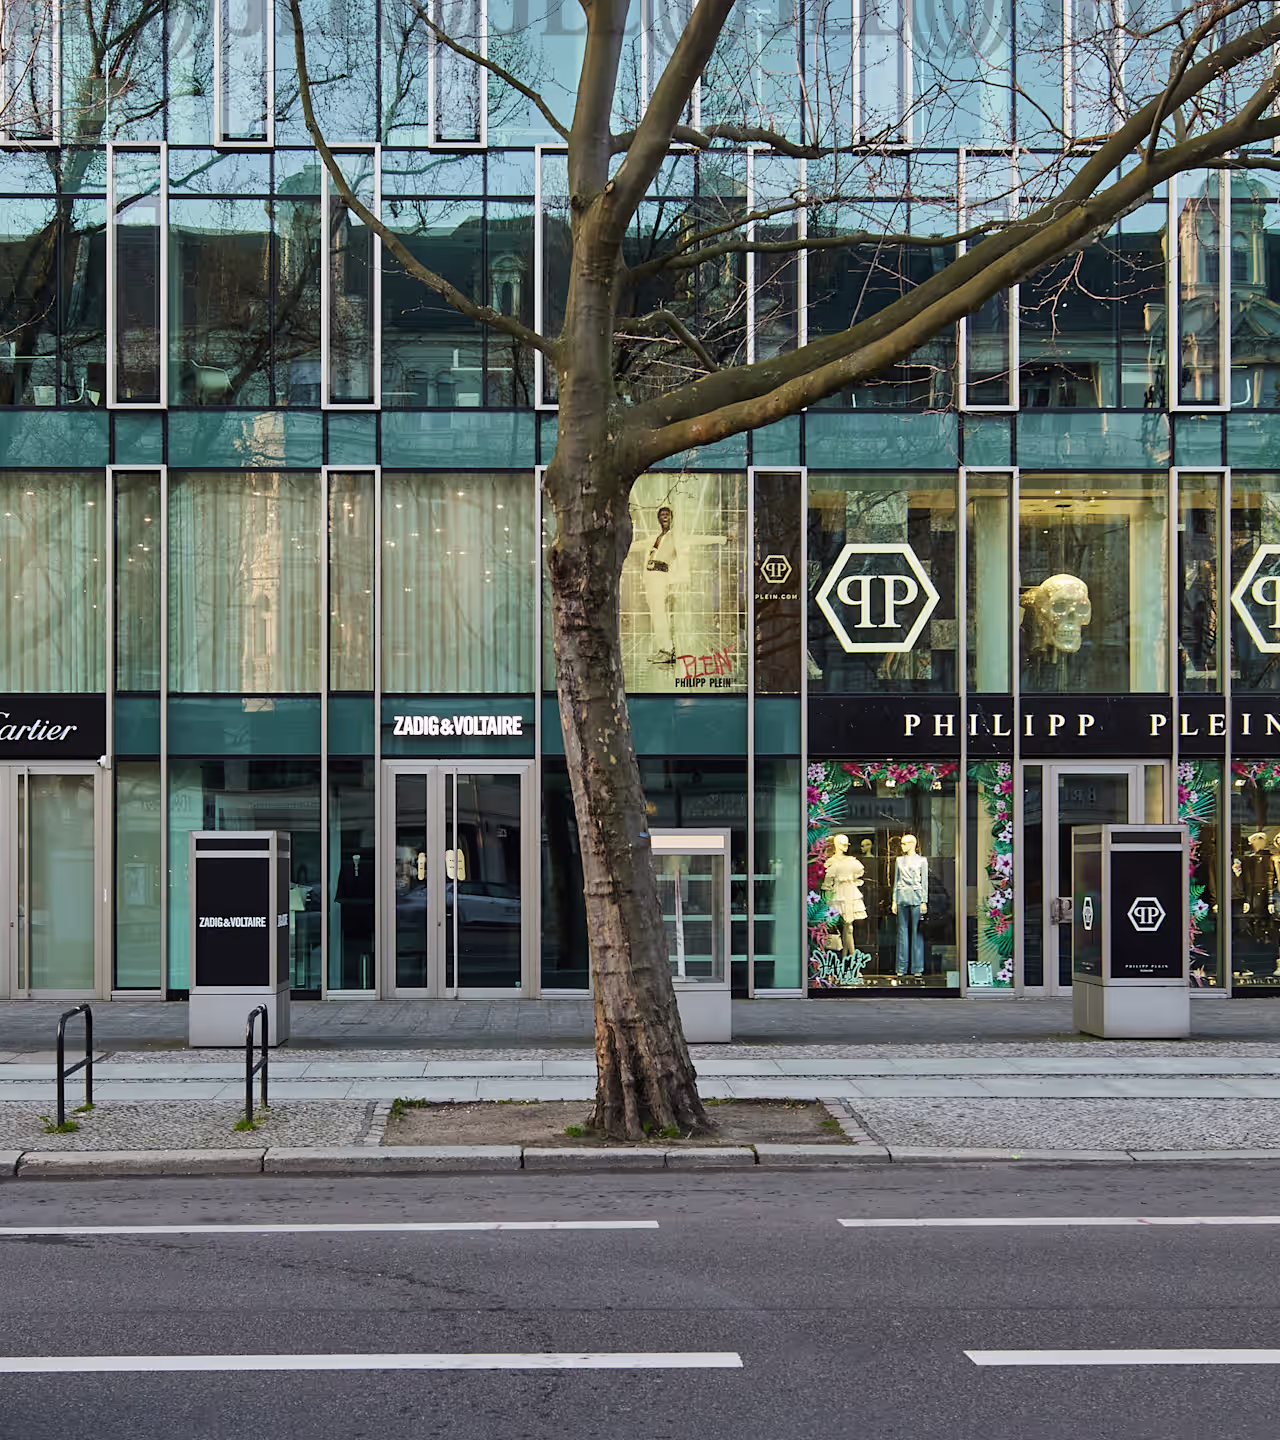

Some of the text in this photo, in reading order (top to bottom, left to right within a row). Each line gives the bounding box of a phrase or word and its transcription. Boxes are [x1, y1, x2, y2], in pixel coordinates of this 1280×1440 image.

[675, 678, 706, 688] PHILIPP
[393, 715, 523, 737] ZADIG&VOLTAIRE
[903, 714, 1096, 737] PHILIPP
[199, 917, 267, 928] ZADIG&VOLTAIRE
